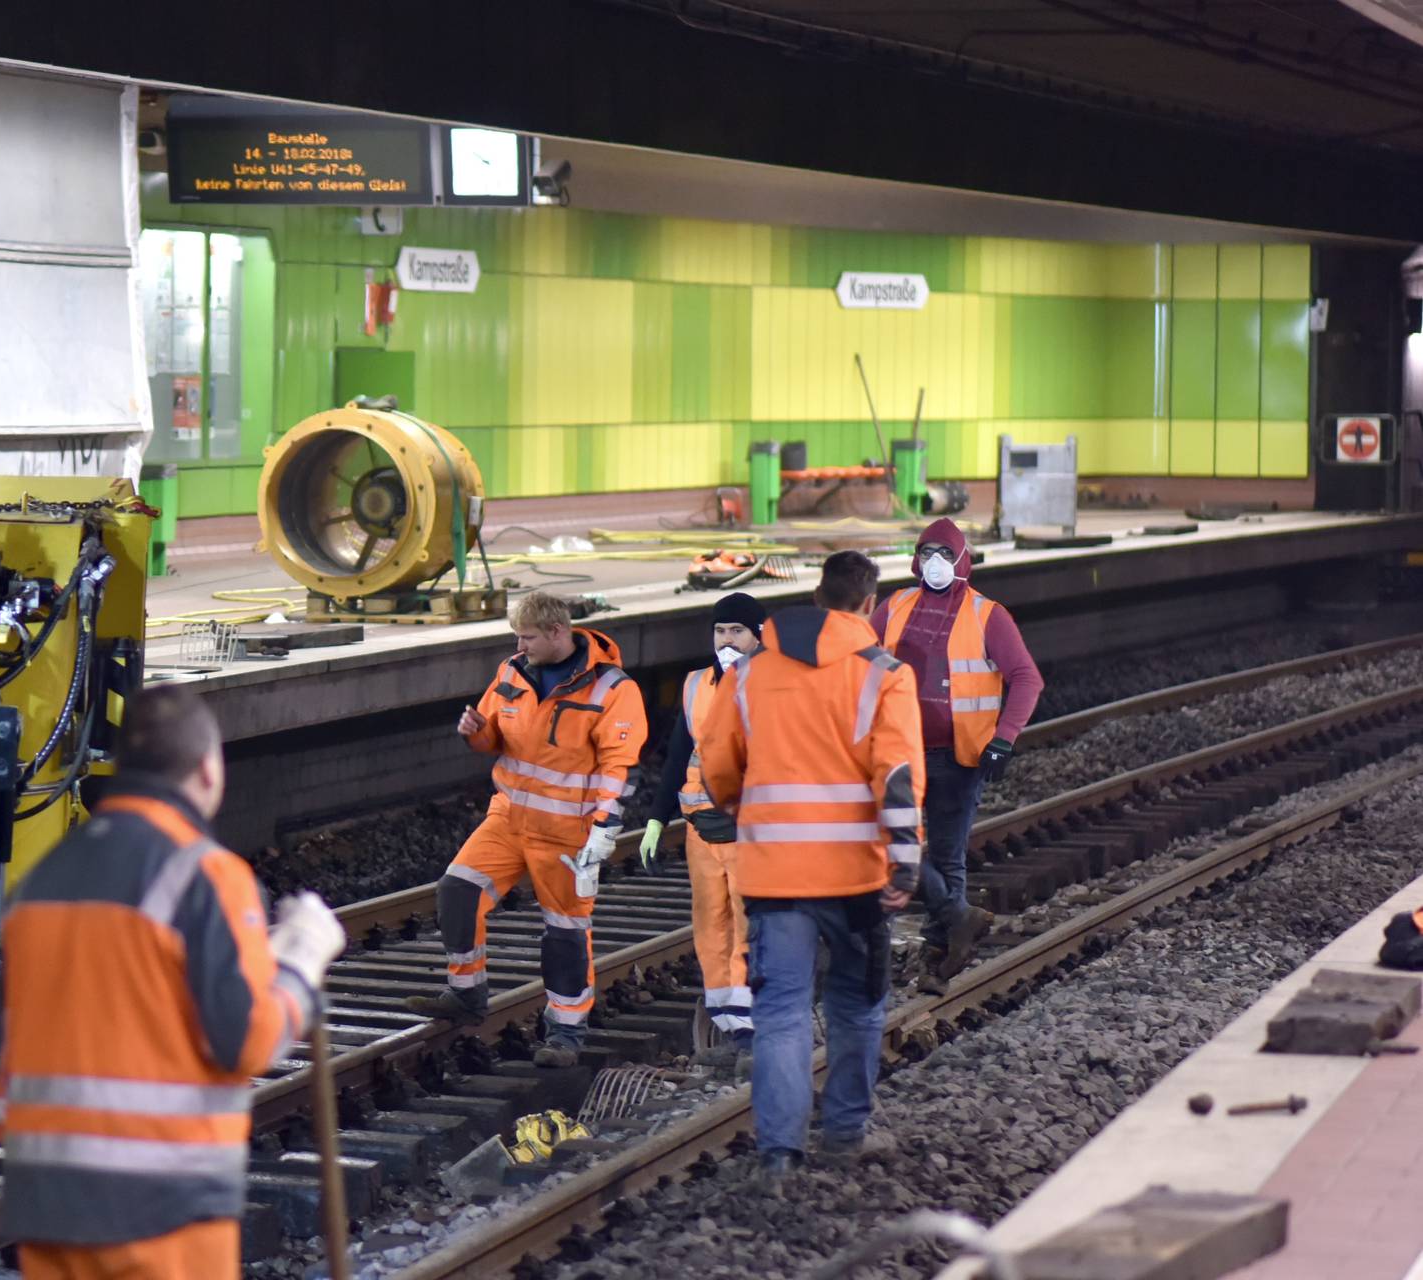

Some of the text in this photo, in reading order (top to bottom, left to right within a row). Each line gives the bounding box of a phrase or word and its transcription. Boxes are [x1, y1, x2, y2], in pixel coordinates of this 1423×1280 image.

[268, 132, 328, 145] Baustelle
[233, 163, 267, 175] Linie
[196, 179, 232, 191] keine
[236, 179, 285, 191] Fahrten
[288, 181, 313, 191] von
[317, 179, 365, 191] diesem
[408, 252, 470, 288] Kampstraße
[850, 276, 917, 306] Kampstraße
